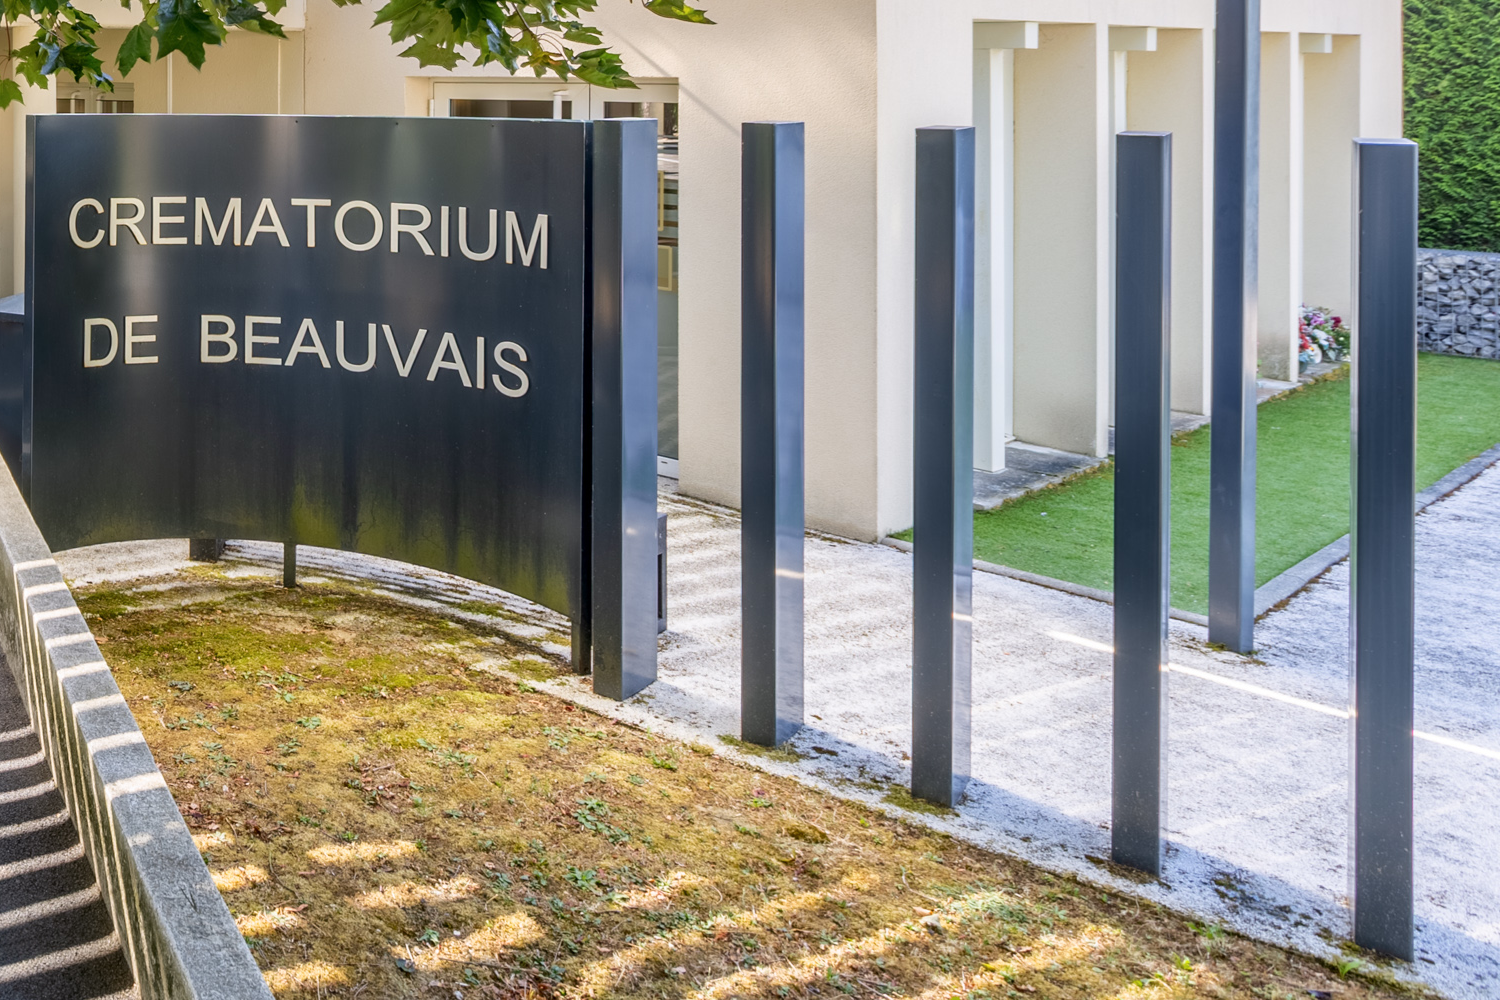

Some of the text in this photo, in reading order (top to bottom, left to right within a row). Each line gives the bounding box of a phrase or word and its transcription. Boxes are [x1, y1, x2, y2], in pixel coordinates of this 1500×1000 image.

[68, 196, 549, 270] CREMATORIUM
[83, 314, 530, 398] DE BEAUVAIS
